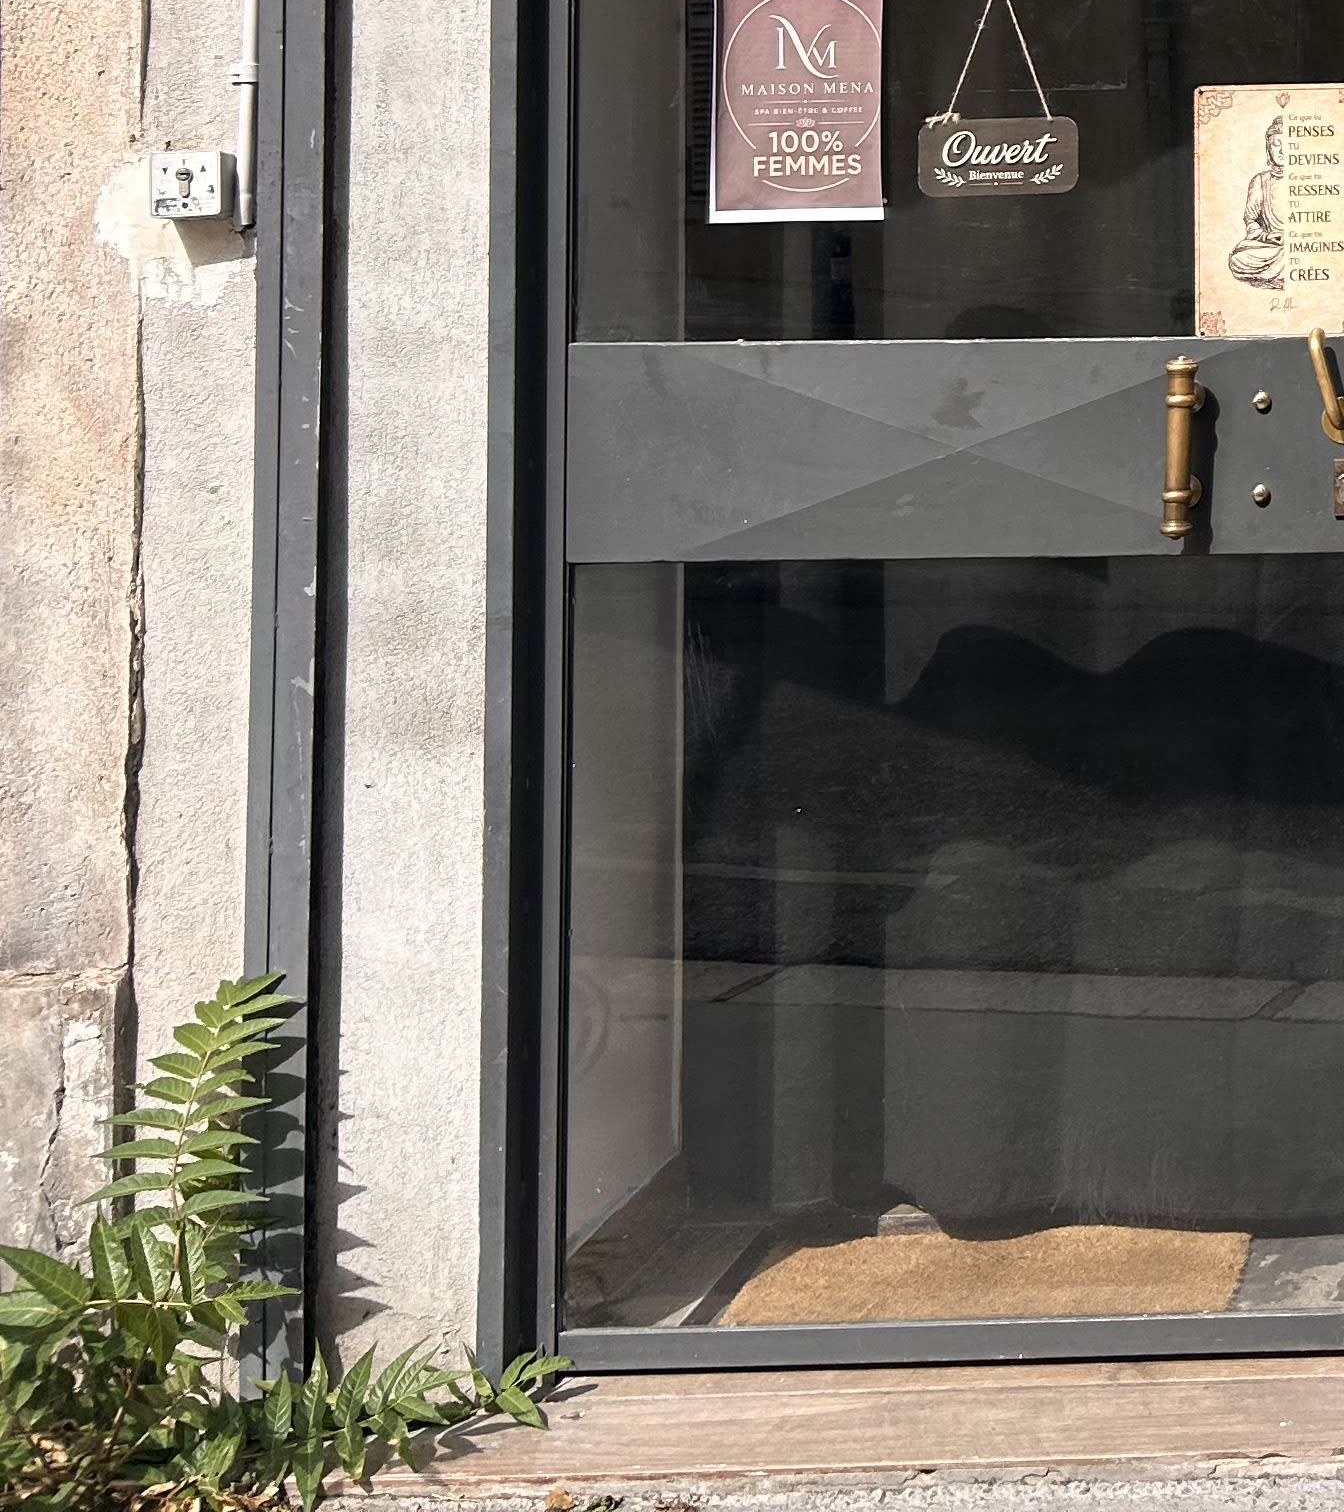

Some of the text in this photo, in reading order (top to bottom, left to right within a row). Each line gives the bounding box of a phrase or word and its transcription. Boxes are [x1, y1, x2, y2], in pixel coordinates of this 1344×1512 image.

[741, 81, 874, 96] MAISON MENA
[1288, 125, 1335, 137] PENSES
[768, 130, 844, 153] 100%
[1288, 142, 1300, 150] TU
[942, 130, 1057, 168] Ouvert
[753, 154, 862, 177] FEMMES
[1288, 153, 1340, 166] DEVIENS
[968, 170, 1025, 181] Bienvenue
[1289, 184, 1340, 196] RESSENS
[1288, 210, 1332, 223] ATTIRE
[1289, 241, 1344, 253] IMAGINES
[1289, 266, 1330, 281] CRÉES
